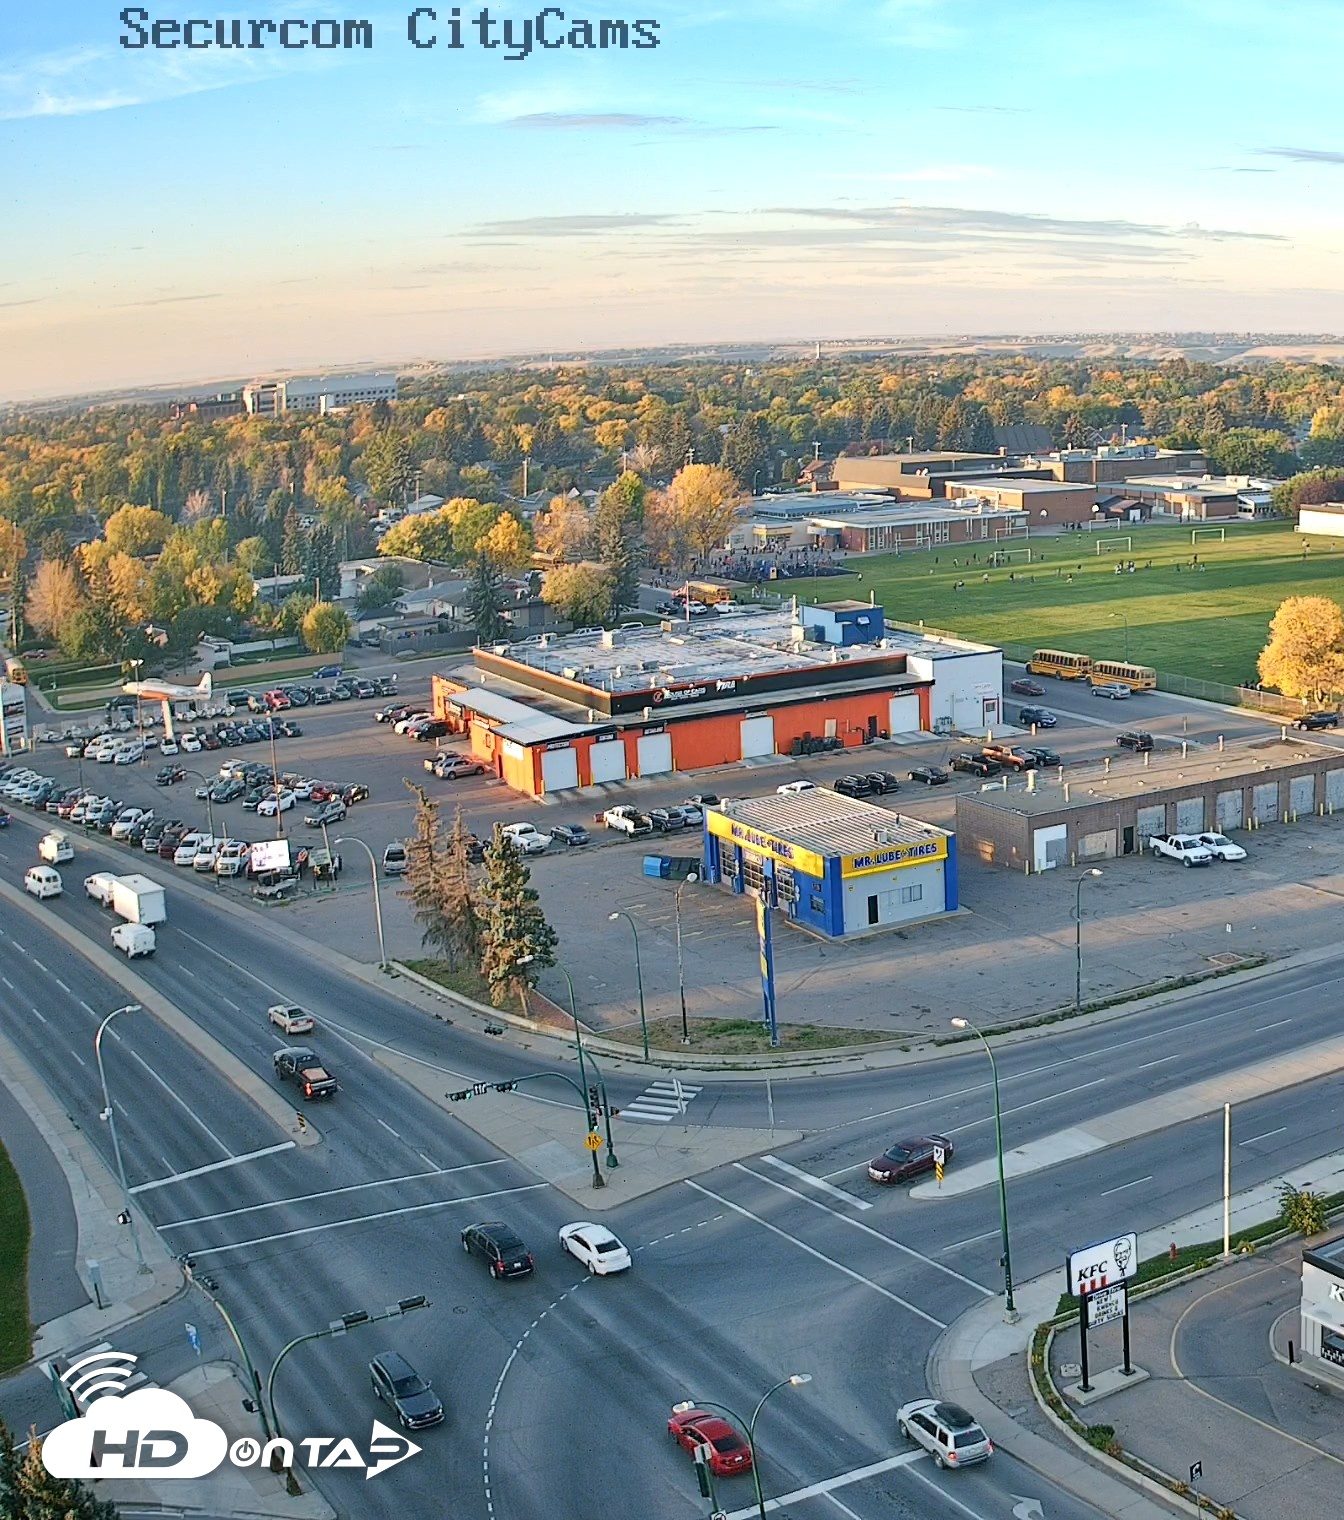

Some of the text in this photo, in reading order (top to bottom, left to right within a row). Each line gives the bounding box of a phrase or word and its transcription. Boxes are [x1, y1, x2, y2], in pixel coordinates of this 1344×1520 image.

[745, 829, 767, 848] LUBE
[772, 839, 794, 859] TIRES
[854, 856, 875, 868] MR.
[876, 850, 901, 864] LUBE
[908, 843, 937, 857] TIRES
[1078, 1260, 1108, 1282] KFC
